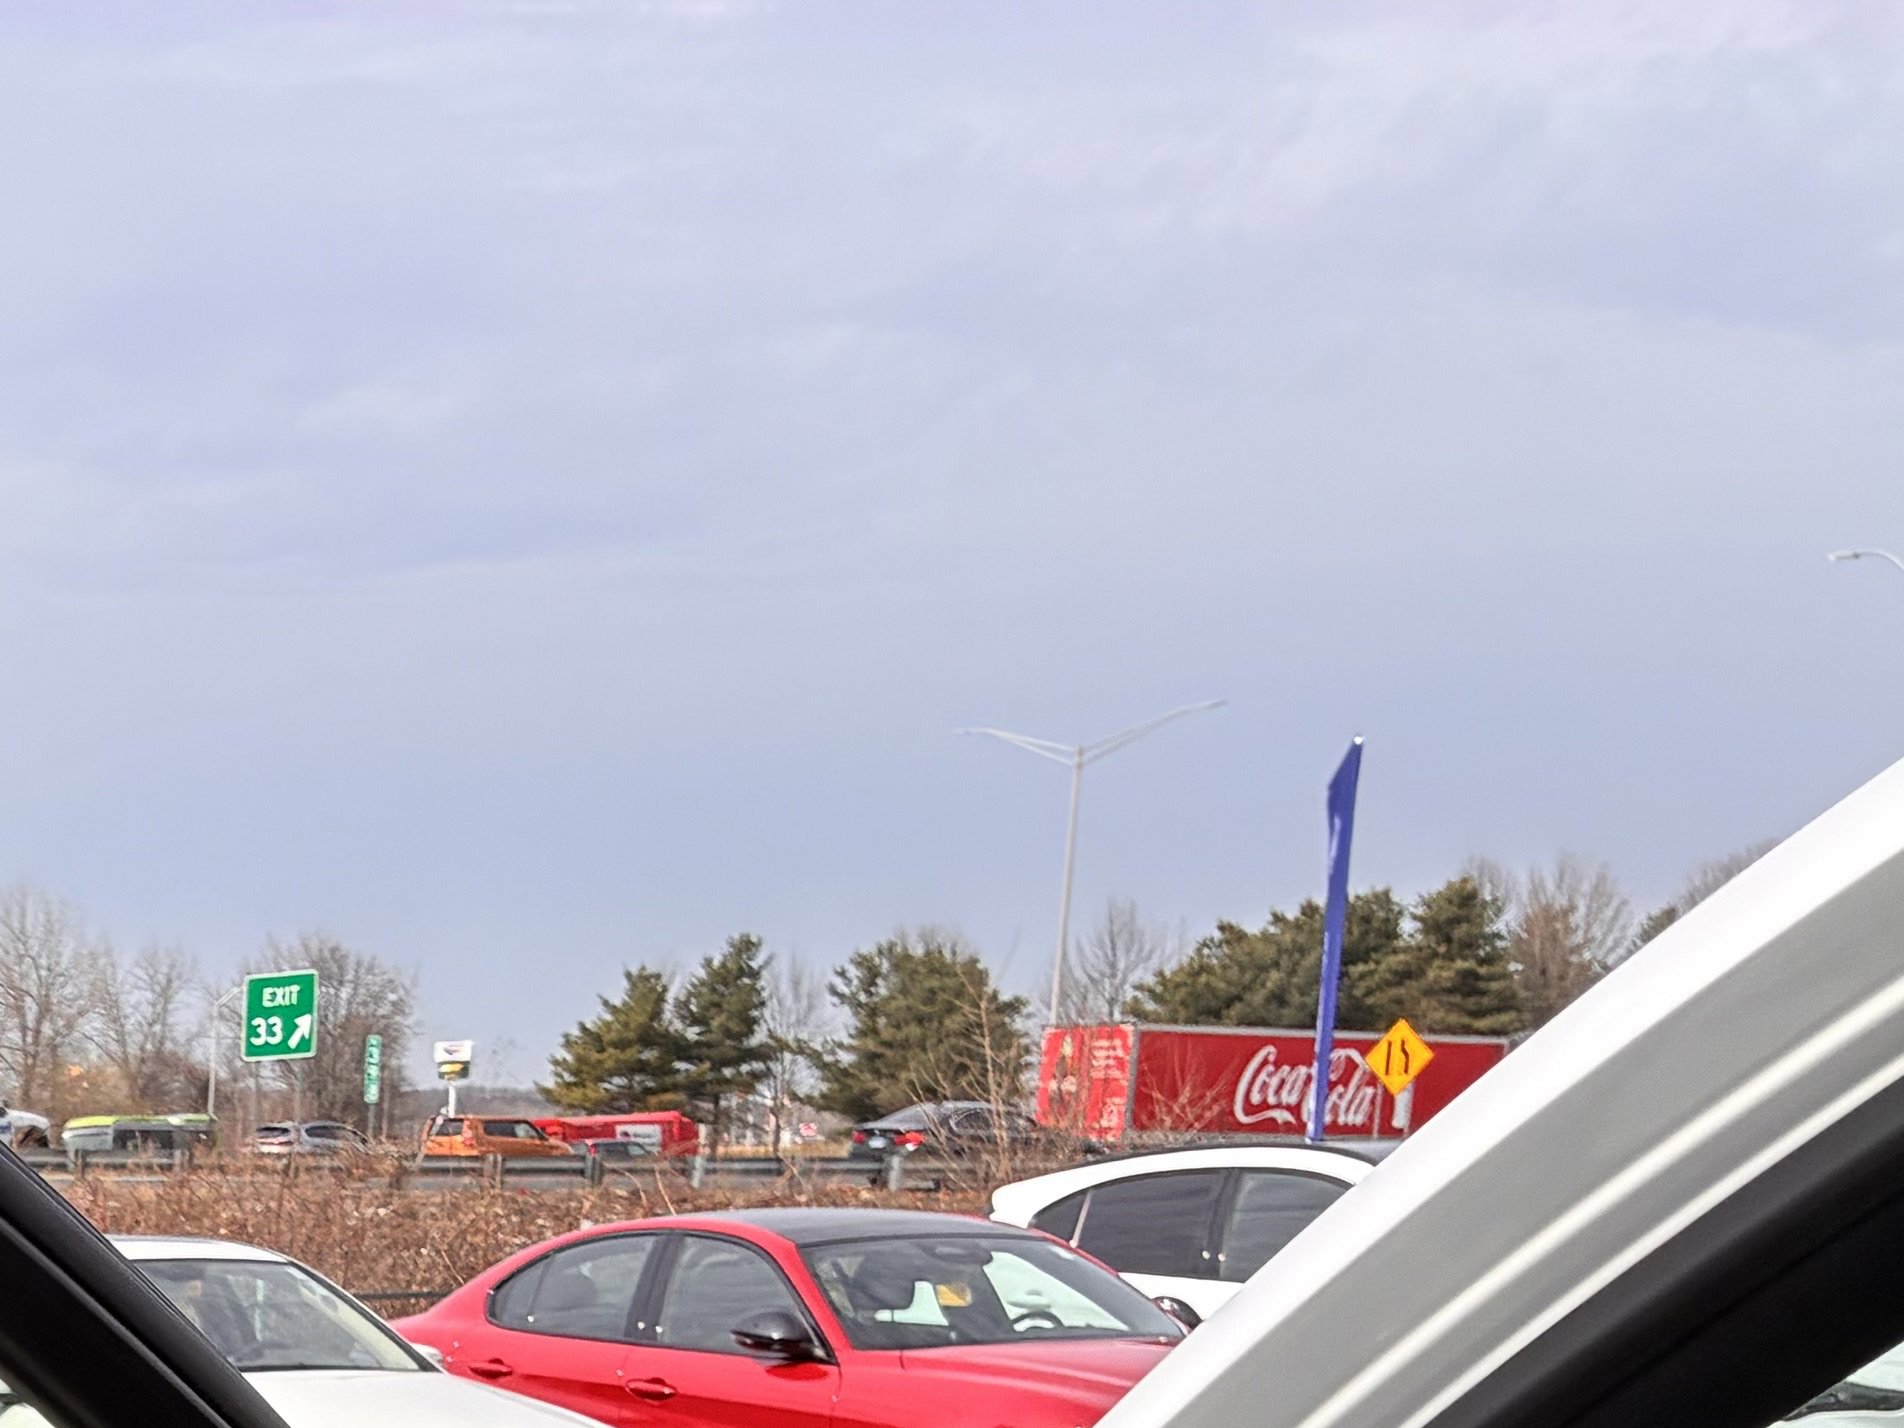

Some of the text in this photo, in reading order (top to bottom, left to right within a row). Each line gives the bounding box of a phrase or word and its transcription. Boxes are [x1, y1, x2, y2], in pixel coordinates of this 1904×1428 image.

[262, 984, 301, 1008] EXIT
[249, 1016, 283, 1046] 33
[1233, 1045, 1376, 1125] CocaCola
